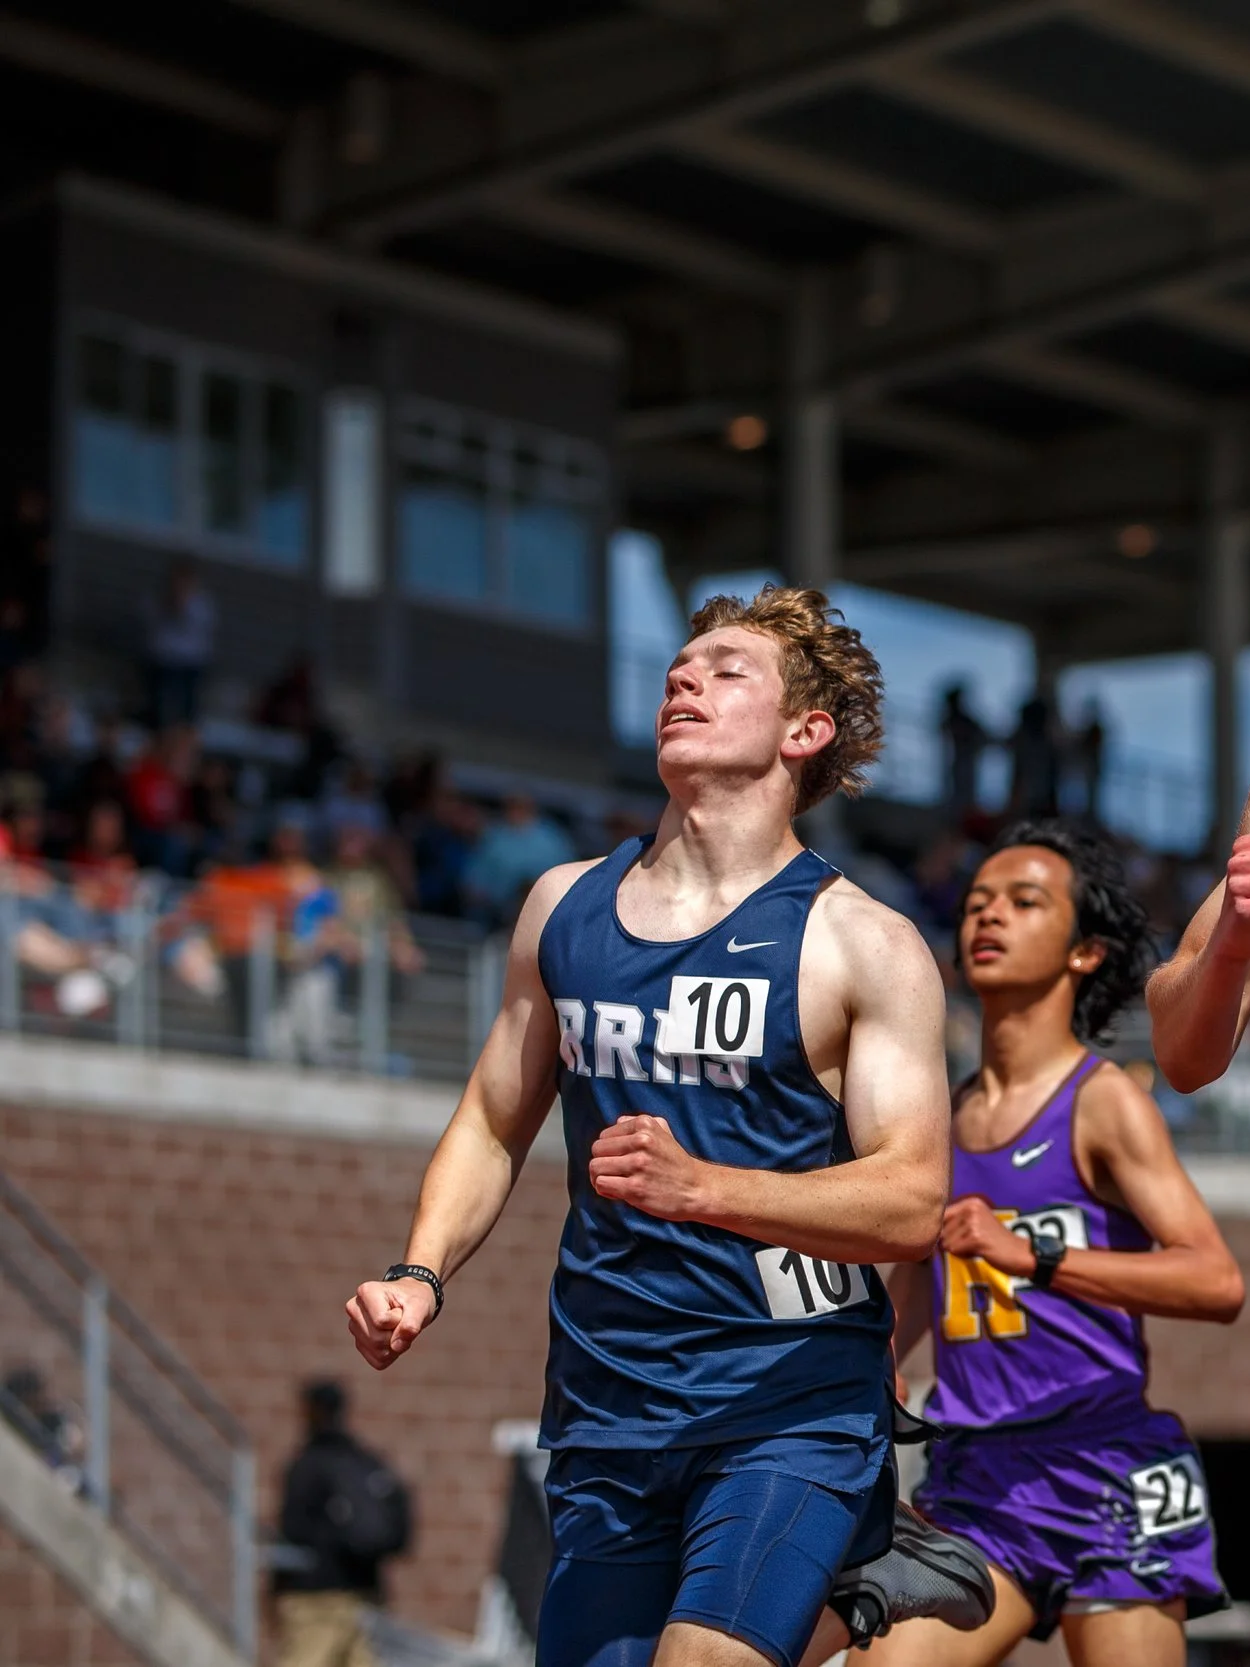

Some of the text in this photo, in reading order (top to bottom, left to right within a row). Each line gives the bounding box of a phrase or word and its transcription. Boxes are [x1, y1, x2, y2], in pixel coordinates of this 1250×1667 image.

[687, 981, 751, 1052] 10
[779, 1249, 851, 1314] 10
[1147, 1463, 1202, 1527] 22
